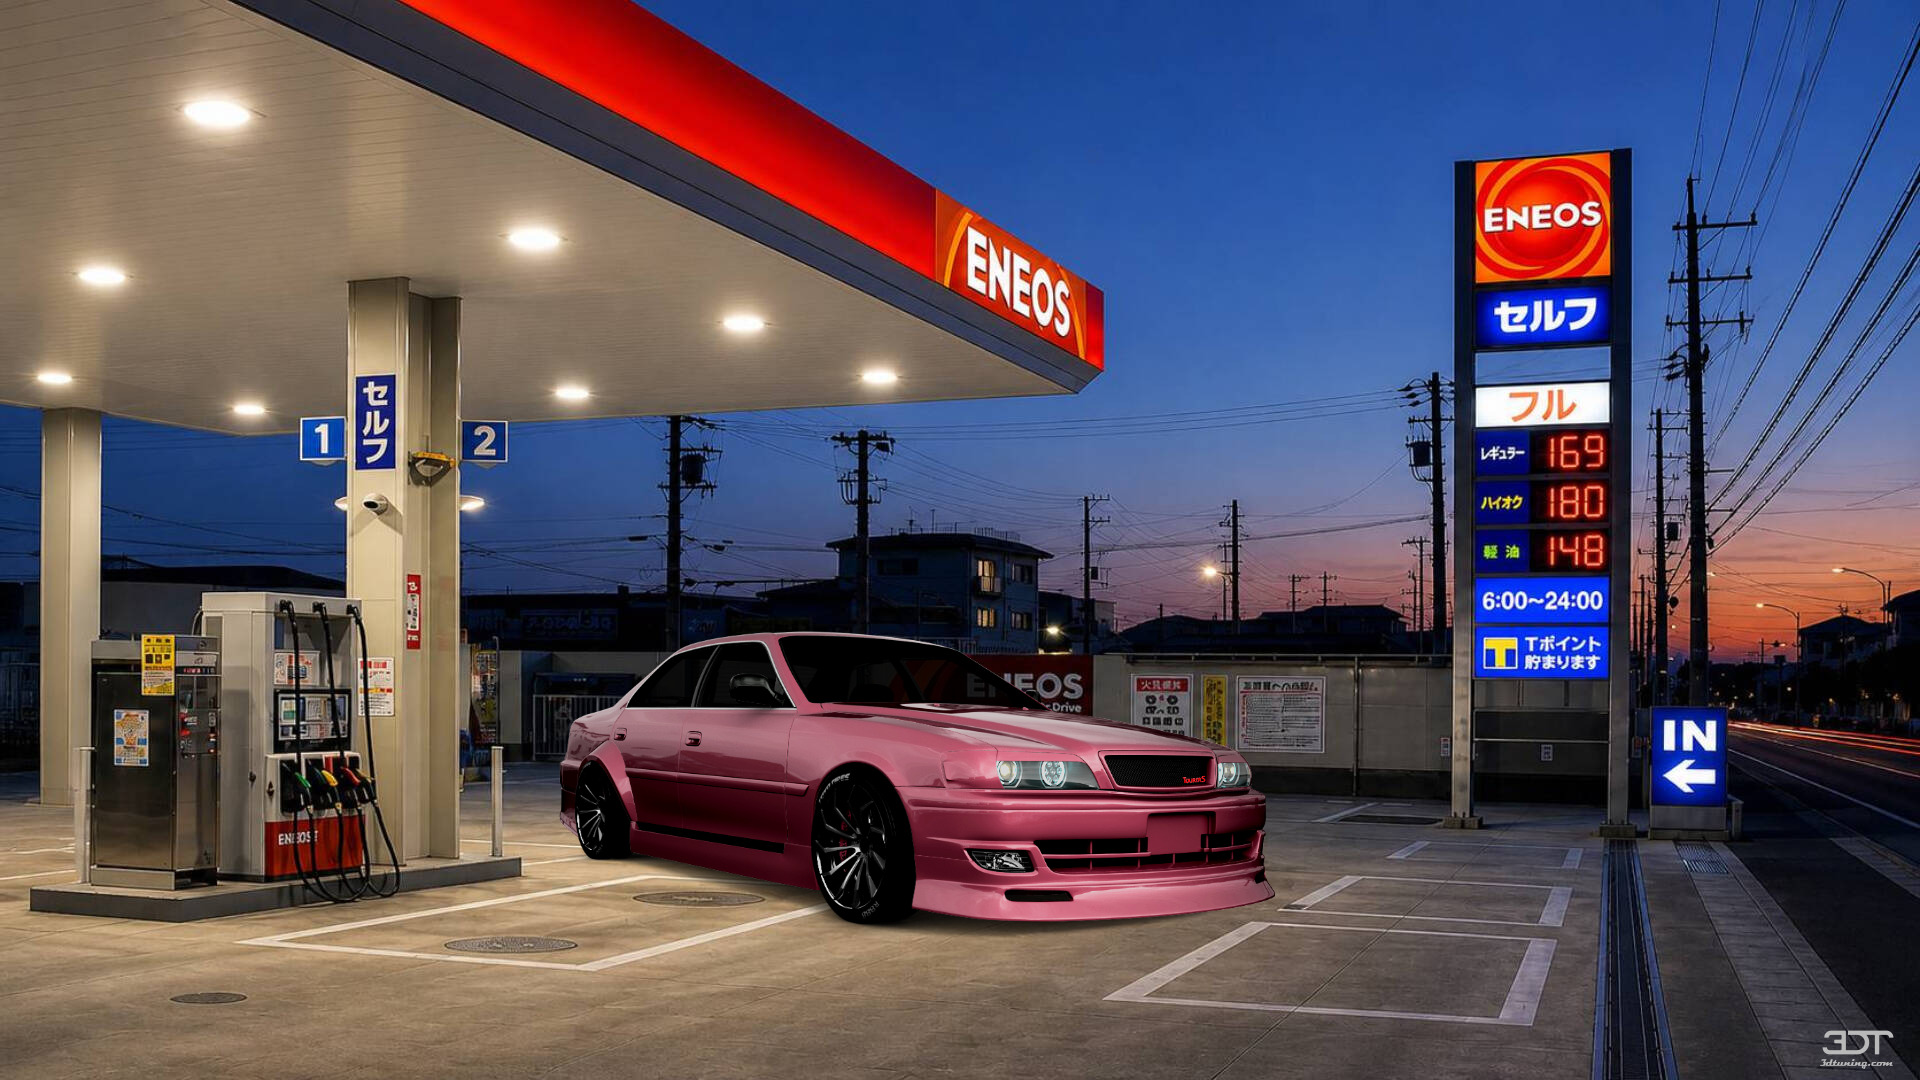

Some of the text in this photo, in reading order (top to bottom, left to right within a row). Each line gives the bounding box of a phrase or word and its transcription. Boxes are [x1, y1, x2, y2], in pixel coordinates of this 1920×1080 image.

[1484, 201, 1602, 233] ENEOS
[967, 226, 1071, 337] ENEOS
[1494, 297, 1597, 333] セルフ
[363, 380, 390, 464] セルフ
[1508, 388, 1577, 423] フル
[314, 423, 329, 454] 1
[473, 425, 497, 456] 2
[1481, 433, 1605, 469] レギュラー 169
[1481, 484, 1605, 519] ハイオク 180
[1549, 533, 1605, 567] 148
[1525, 635, 1602, 653] Tポイント
[1524, 654, 1602, 670] 貯まります
[1663, 719, 1717, 752] IN
